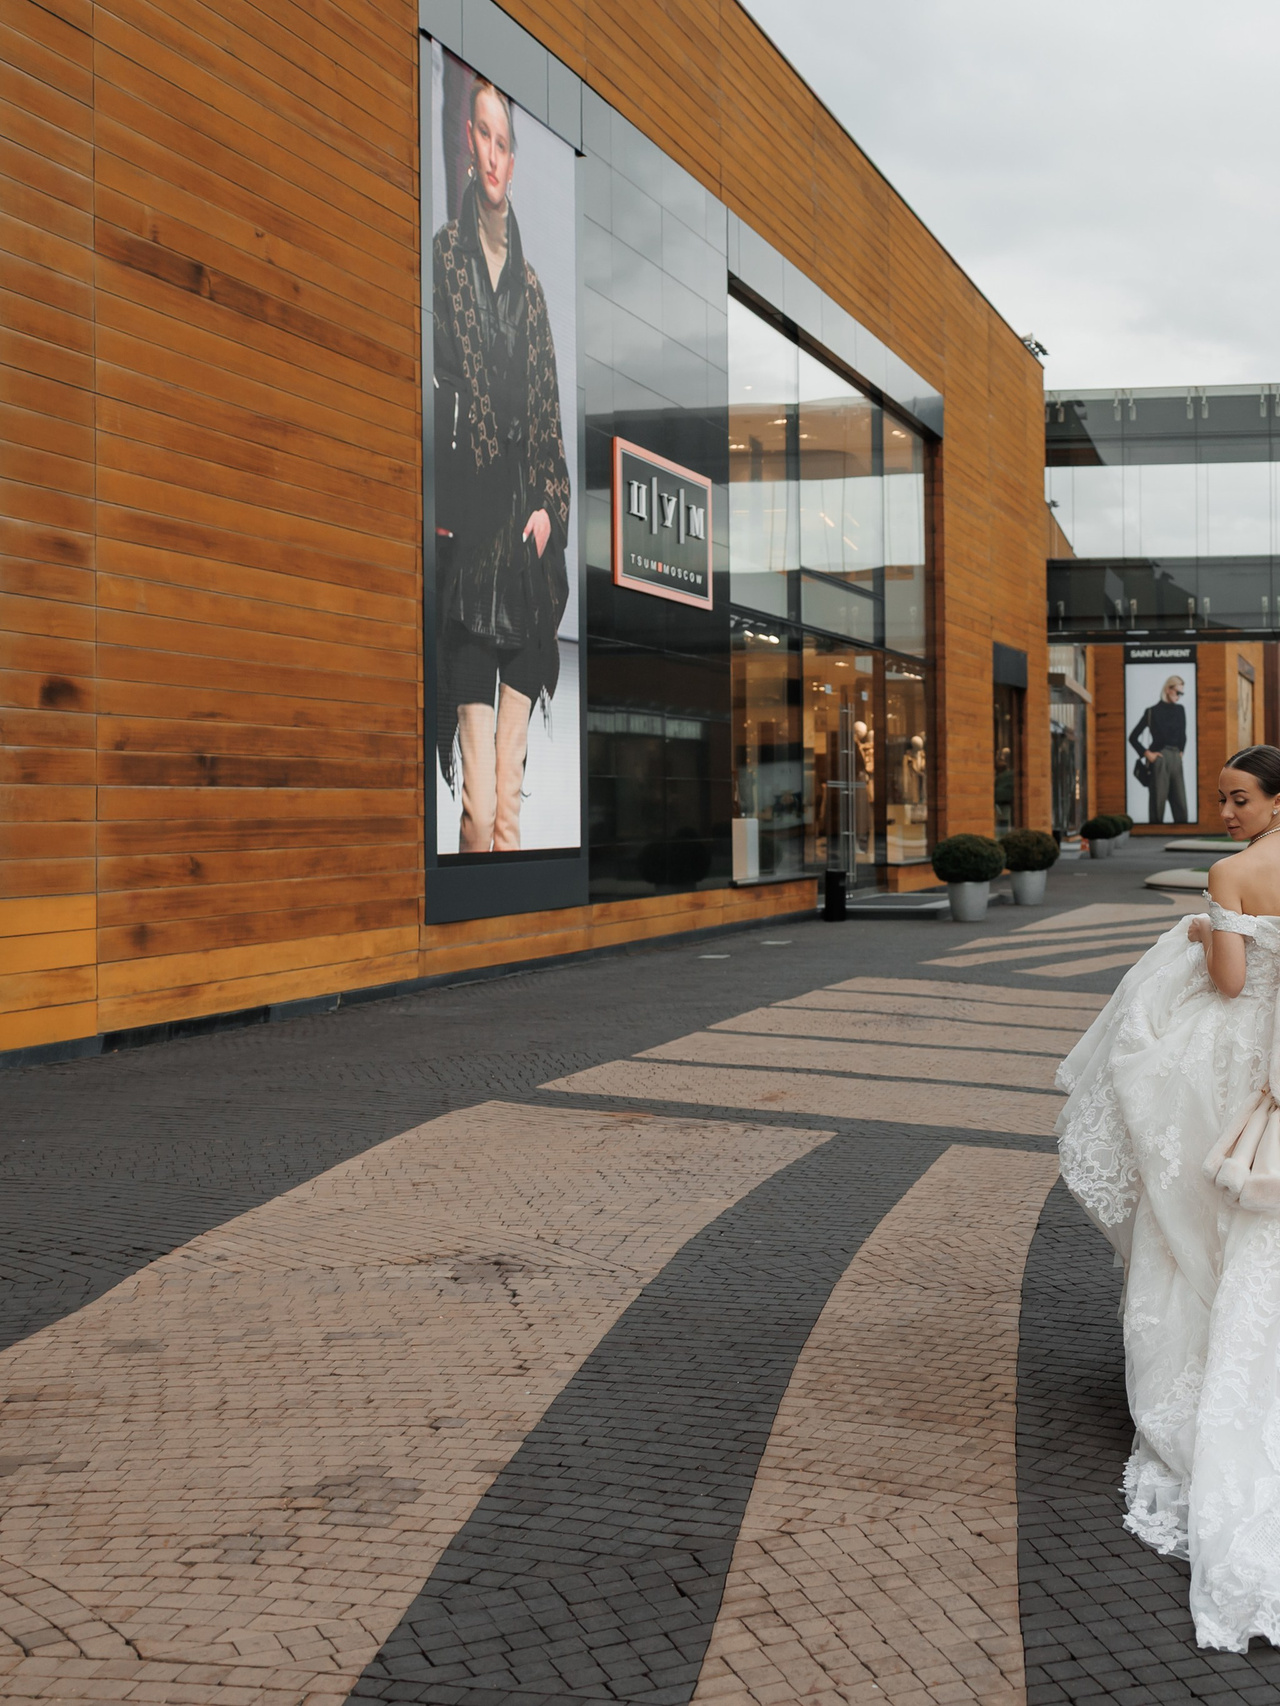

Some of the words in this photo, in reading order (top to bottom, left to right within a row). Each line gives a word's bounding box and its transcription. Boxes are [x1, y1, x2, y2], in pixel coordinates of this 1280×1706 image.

[630, 553, 658, 572] TSUM
[663, 563, 703, 584] MOSCOW
[1130, 649, 1153, 658] SAINT
[1154, 649, 1191, 657] LAURENT
